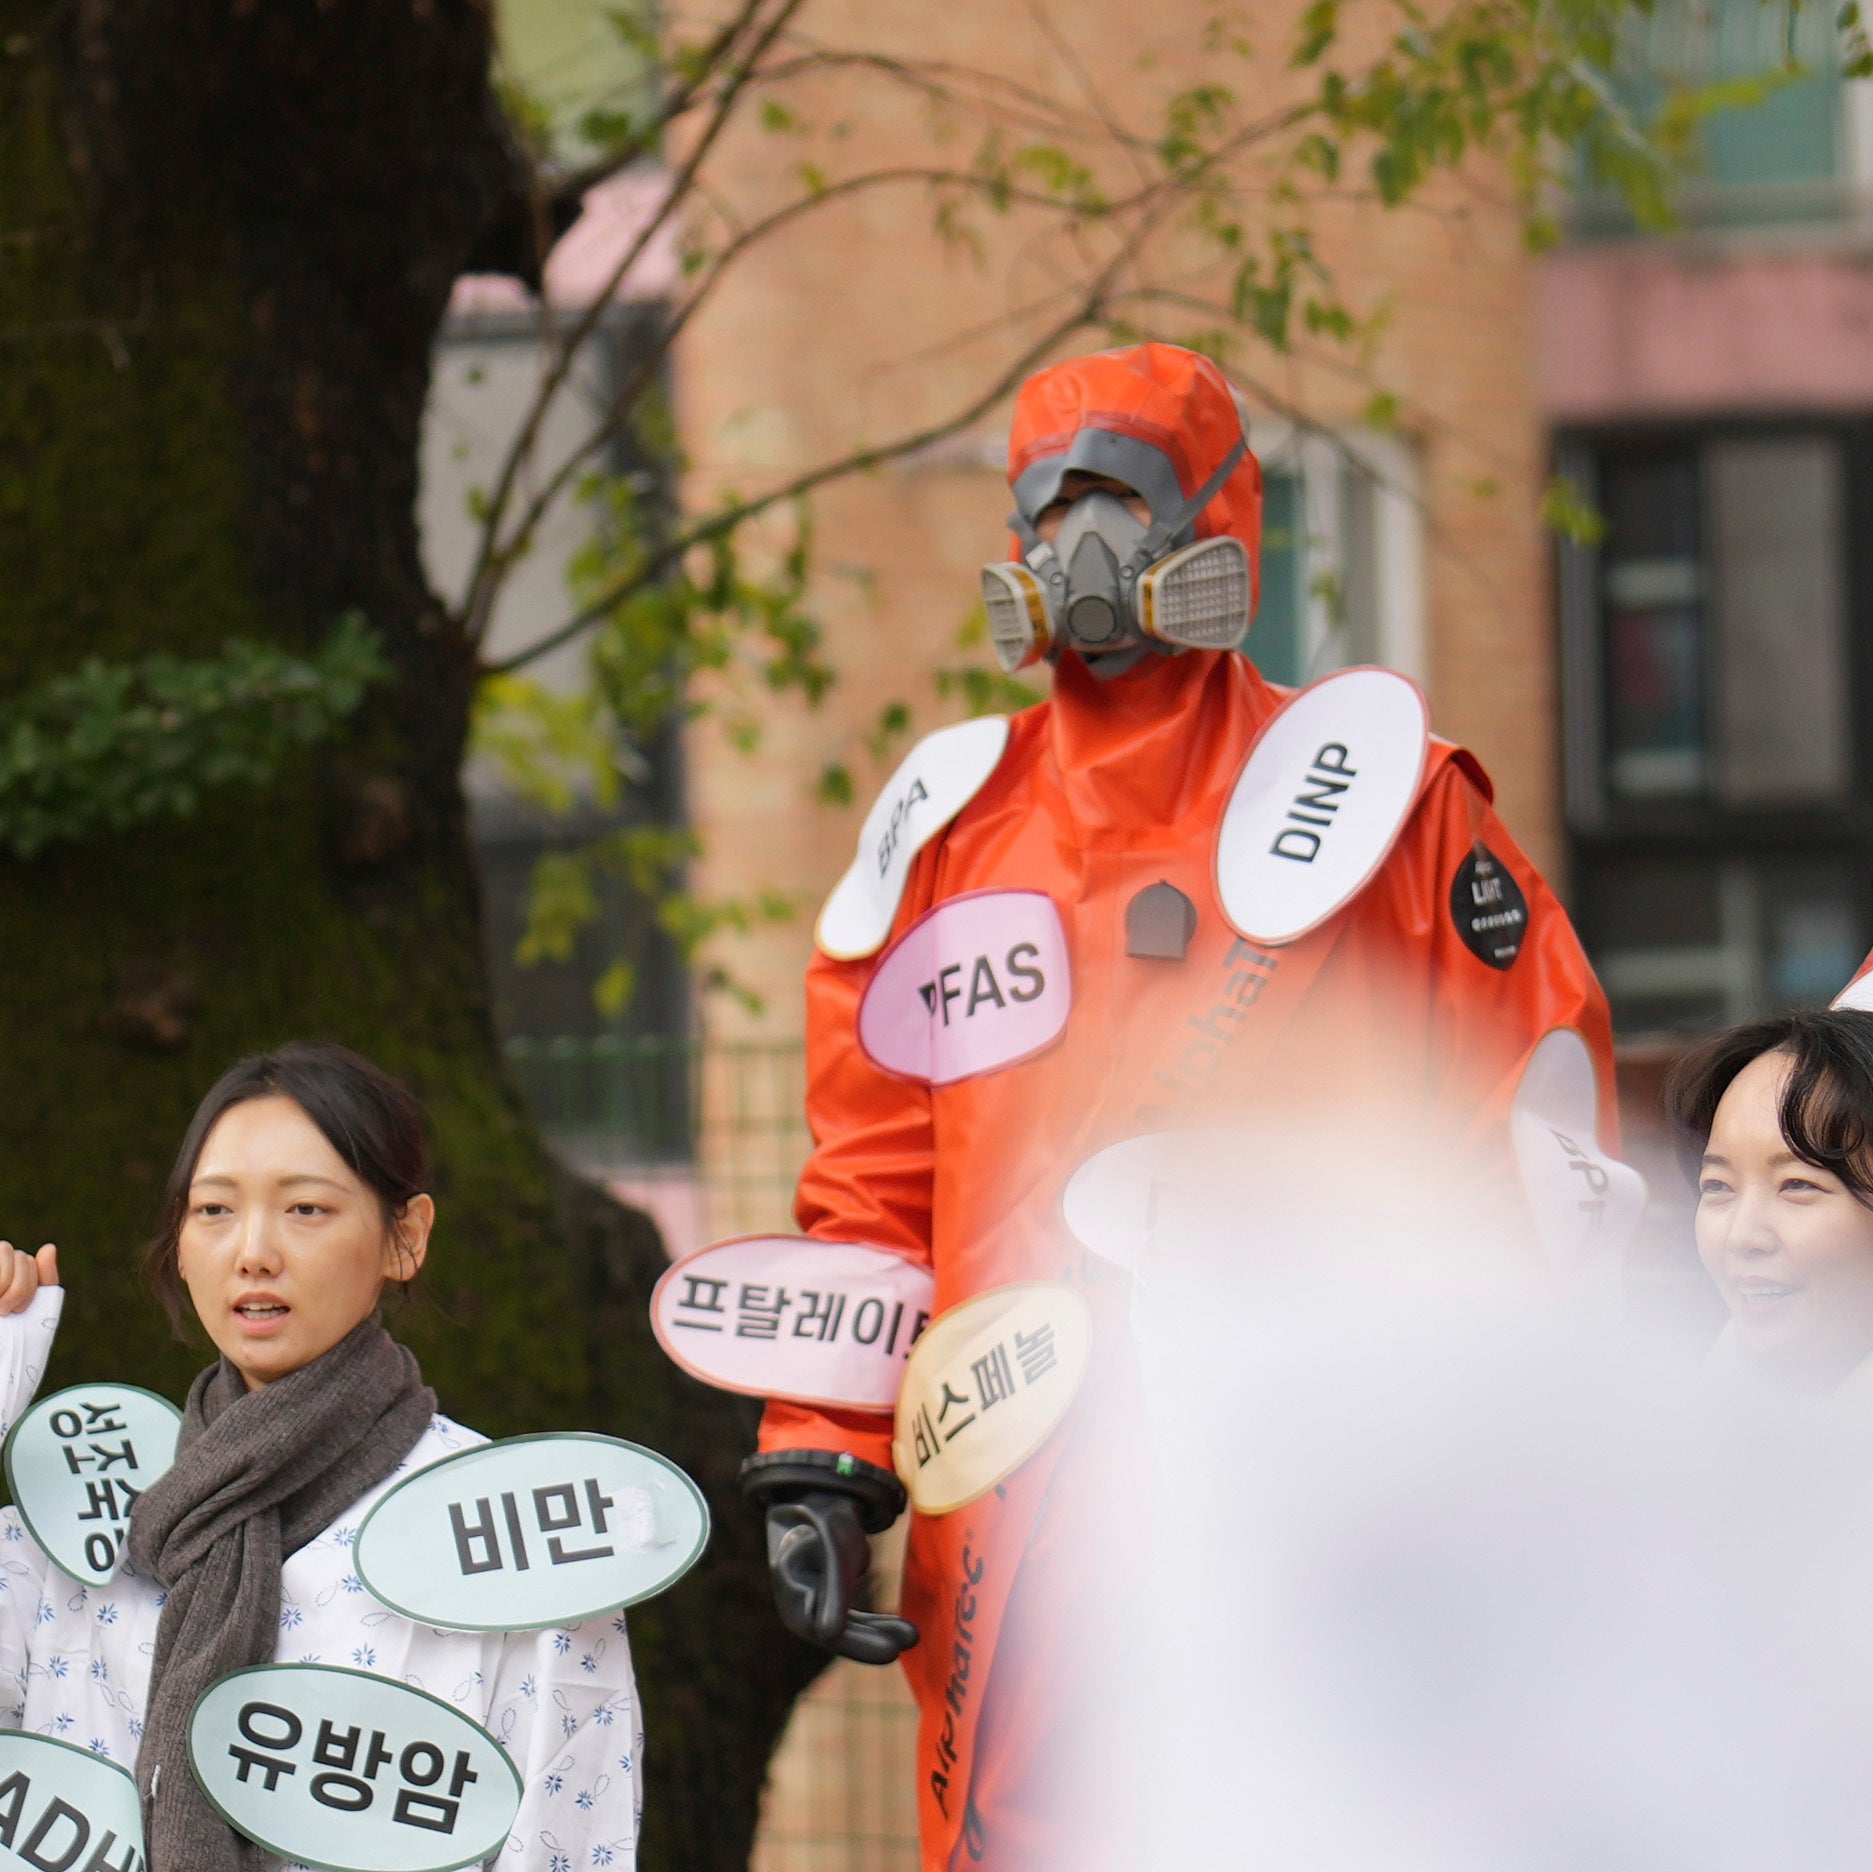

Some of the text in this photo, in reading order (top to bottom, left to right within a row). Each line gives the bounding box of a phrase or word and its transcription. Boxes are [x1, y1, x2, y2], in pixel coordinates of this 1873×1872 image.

[1269, 741, 1357, 863] DINP
[911, 1321, 1057, 1470] 비스페놀
[447, 1478, 614, 1576] 비만
[228, 1701, 478, 1836] 유방암
